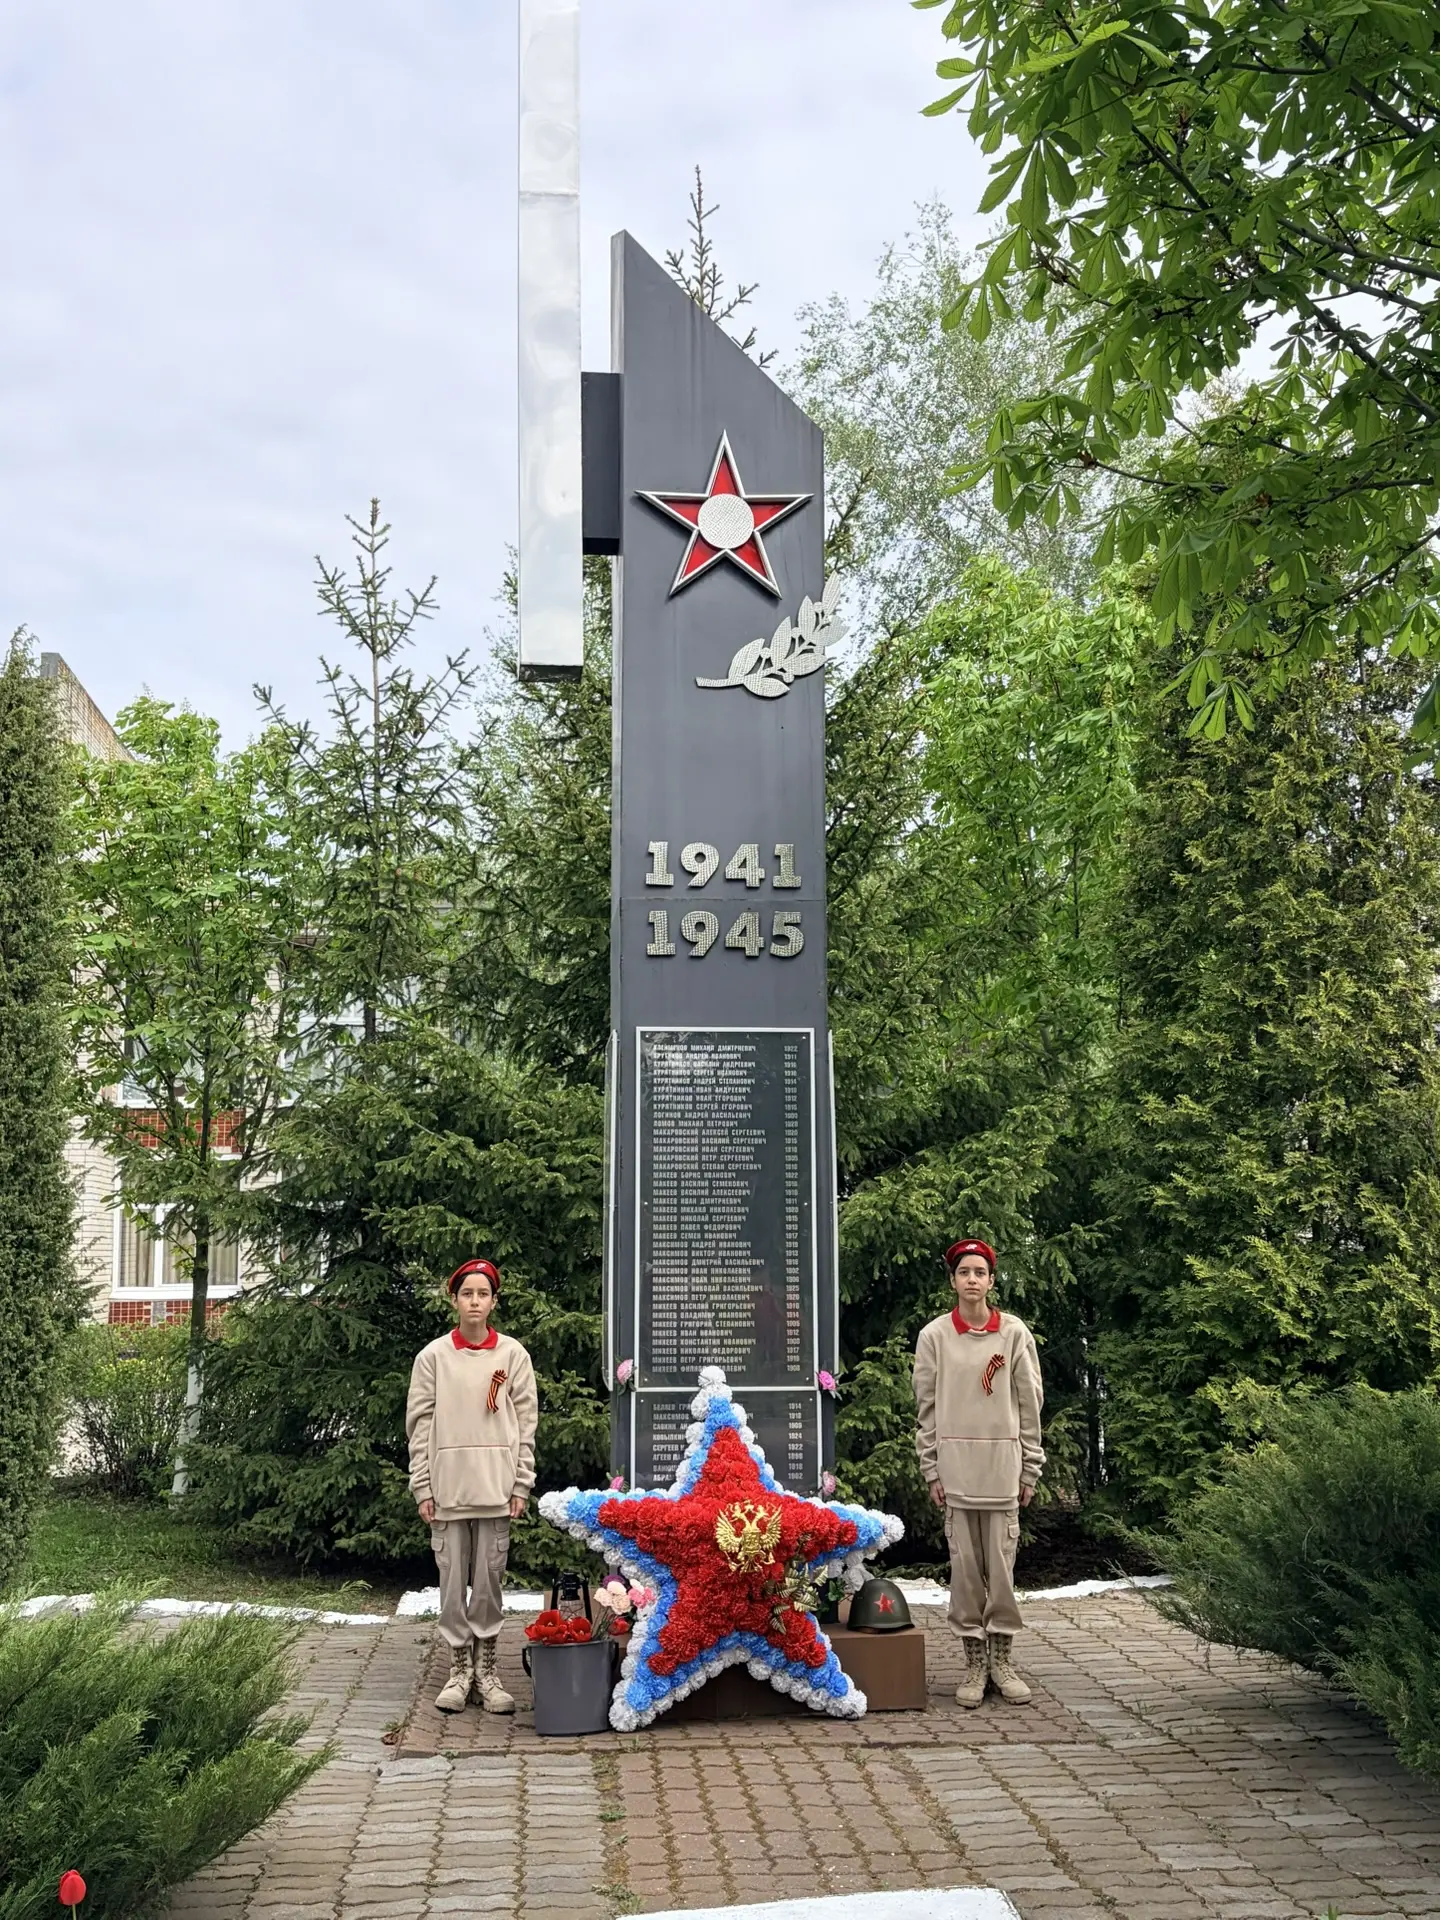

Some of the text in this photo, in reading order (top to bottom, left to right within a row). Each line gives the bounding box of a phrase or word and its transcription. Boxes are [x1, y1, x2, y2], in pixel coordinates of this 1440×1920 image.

[646, 841, 802, 888] 1941
[646, 910, 804, 957] 1945
[684, 1111, 708, 1119] АНДРЕЙ
[732, 1128, 765, 1136] СЕРГЕЕВИЧ
[721, 1145, 754, 1153] СЕРГЕЕВИЧ
[704, 1171, 736, 1179] ИВАНОВИЧ
[700, 1197, 741, 1205] ДМИТРИЕВИЧ
[704, 1223, 741, 1231] ФЕДОРОВИЧ
[704, 1232, 737, 1240] ИВАНОВИЧ
[691, 1258, 721, 1266] ДМИТРИЙ
[725, 1258, 764, 1266] ВАСИЛЬЕВИЧ
[711, 1267, 751, 1275] НИКОЛАЕВИЧ
[711, 1276, 751, 1284] НИКОЛАЕВИЧ
[700, 1329, 732, 1337] ИВАНОВИЧ
[680, 1338, 720, 1346] КОНСТАНТИН
[724, 1338, 756, 1346] ИВАНОВИЧ
[680, 1347, 708, 1355] НИКОЛАЙ
[712, 1347, 751, 1355] ФЕДОРОВИЧ
